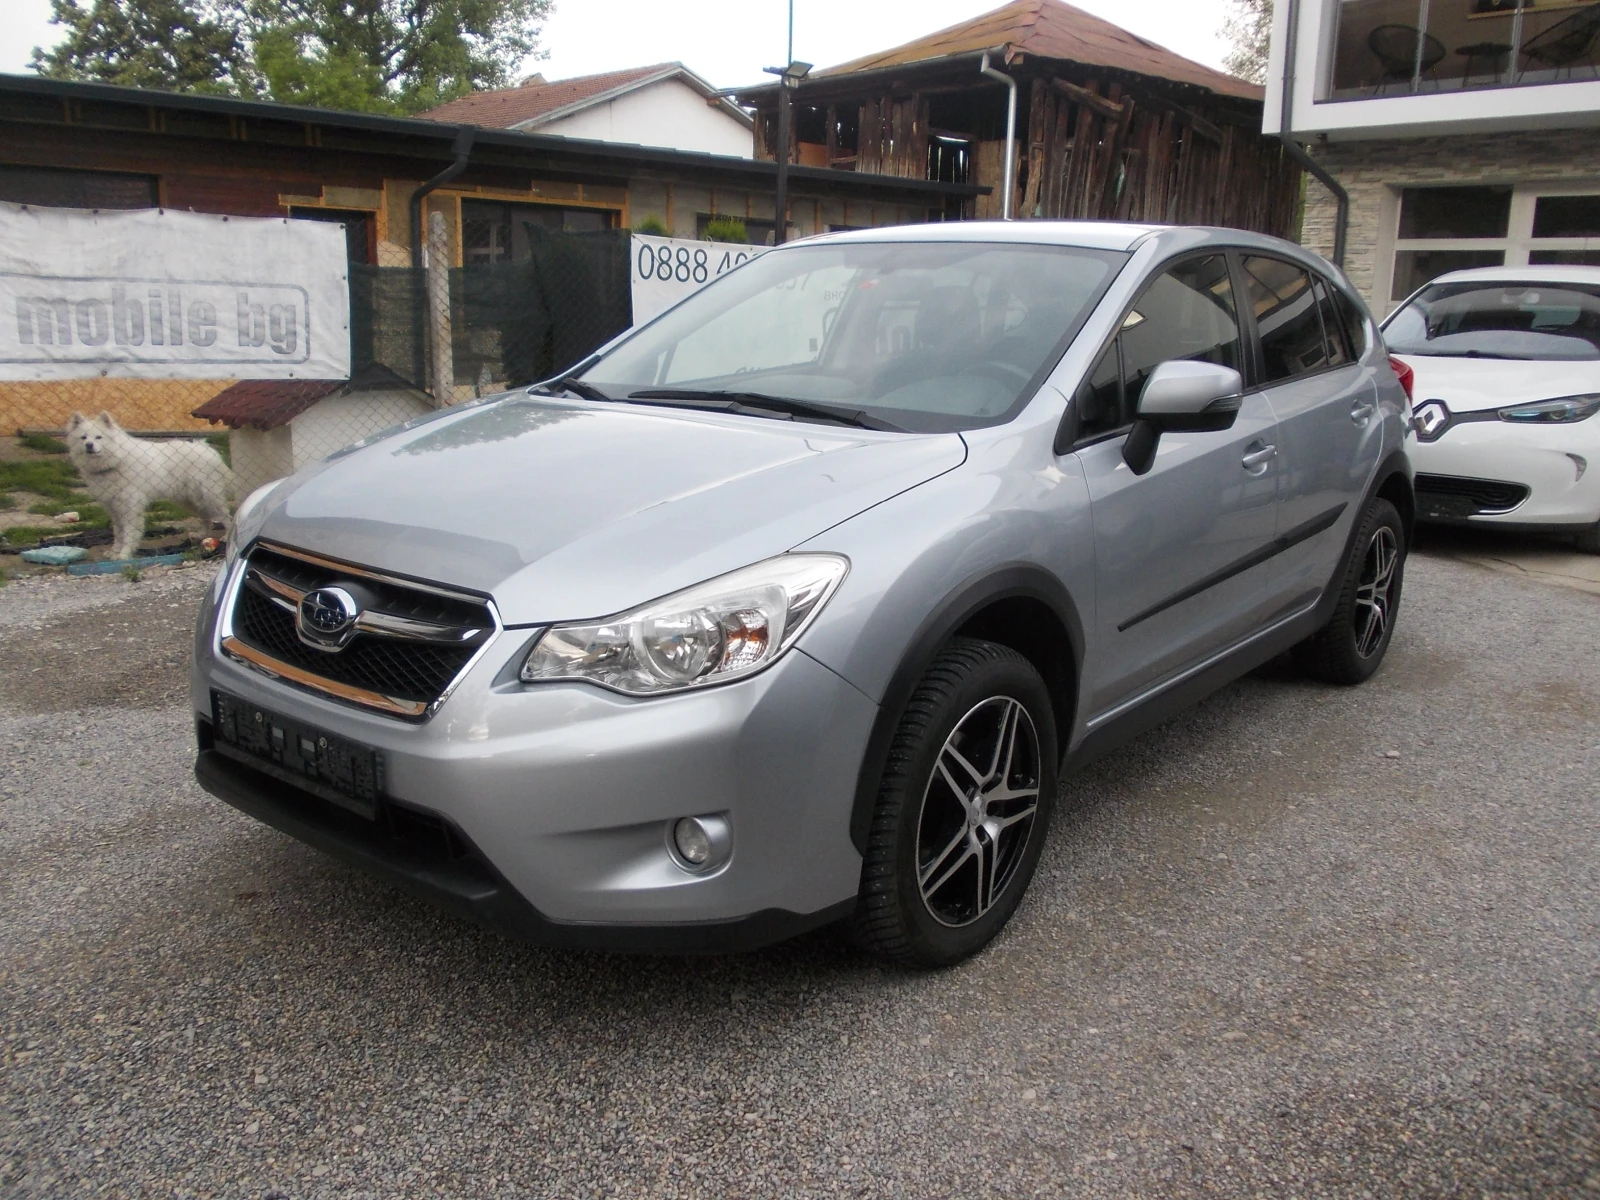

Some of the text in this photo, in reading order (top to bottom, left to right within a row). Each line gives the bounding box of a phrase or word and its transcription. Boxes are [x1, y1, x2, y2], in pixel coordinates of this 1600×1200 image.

[638, 244, 708, 283] 0888
[16, 287, 297, 354] mobile bg
